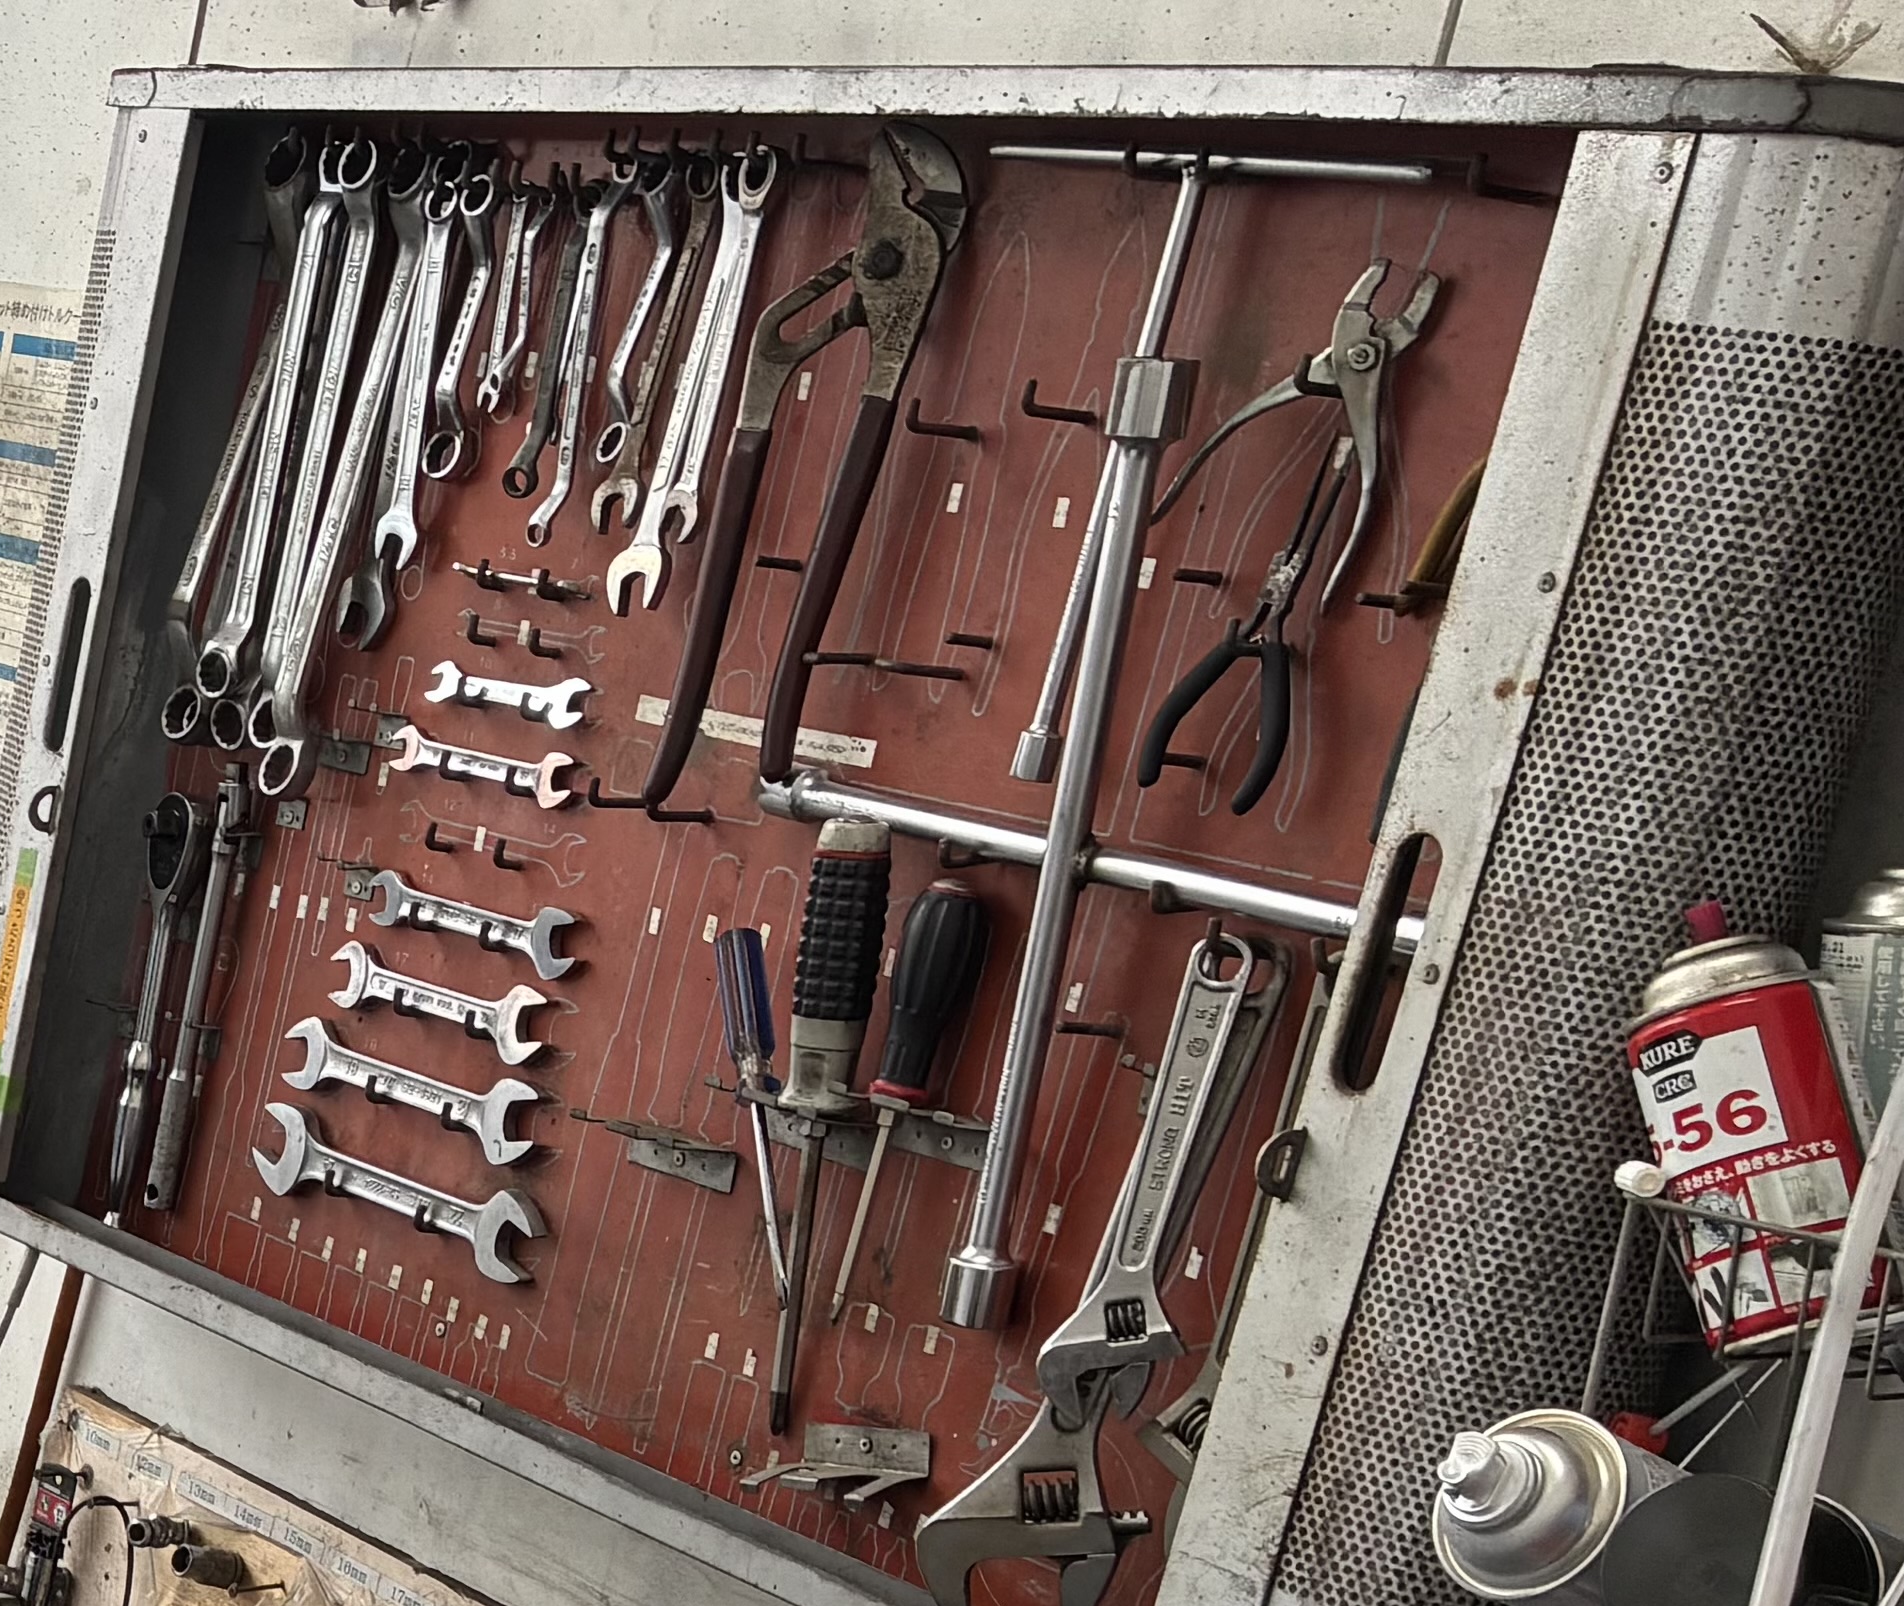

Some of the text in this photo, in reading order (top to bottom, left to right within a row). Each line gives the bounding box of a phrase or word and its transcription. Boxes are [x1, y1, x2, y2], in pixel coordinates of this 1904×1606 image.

[1639, 1035, 1694, 1071] KURE
[1655, 1073, 1693, 1099] CRC
[188, 1480, 216, 1506] 13mm
[234, 1504, 263, 1530] 14mm
[283, 1527, 312, 1554] 15mm
